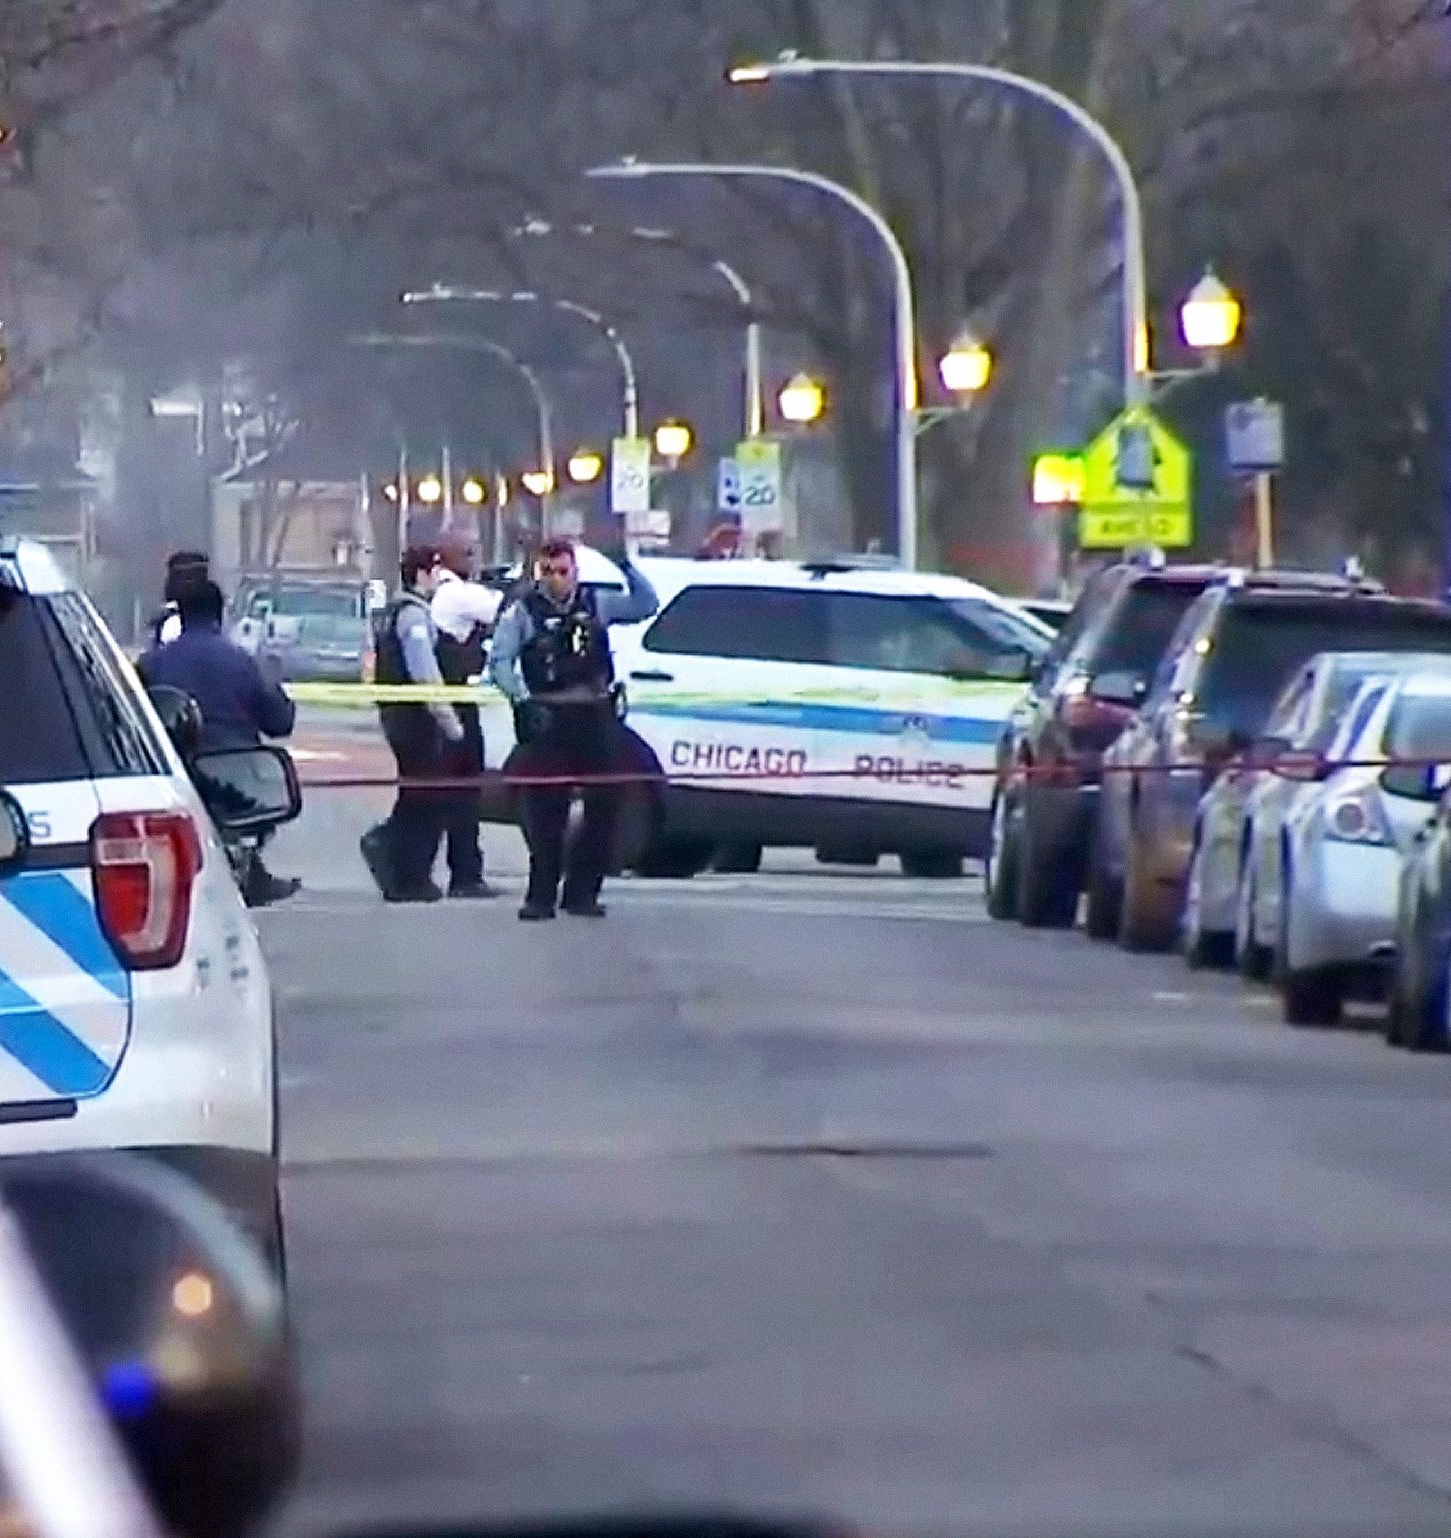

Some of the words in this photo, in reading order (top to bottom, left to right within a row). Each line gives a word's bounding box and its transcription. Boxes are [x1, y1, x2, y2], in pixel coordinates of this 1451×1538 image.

[744, 484, 777, 505] 20
[1099, 517, 1173, 536] AHED
[671, 741, 807, 776] CHICAGO
[855, 755, 965, 789] POLICE
